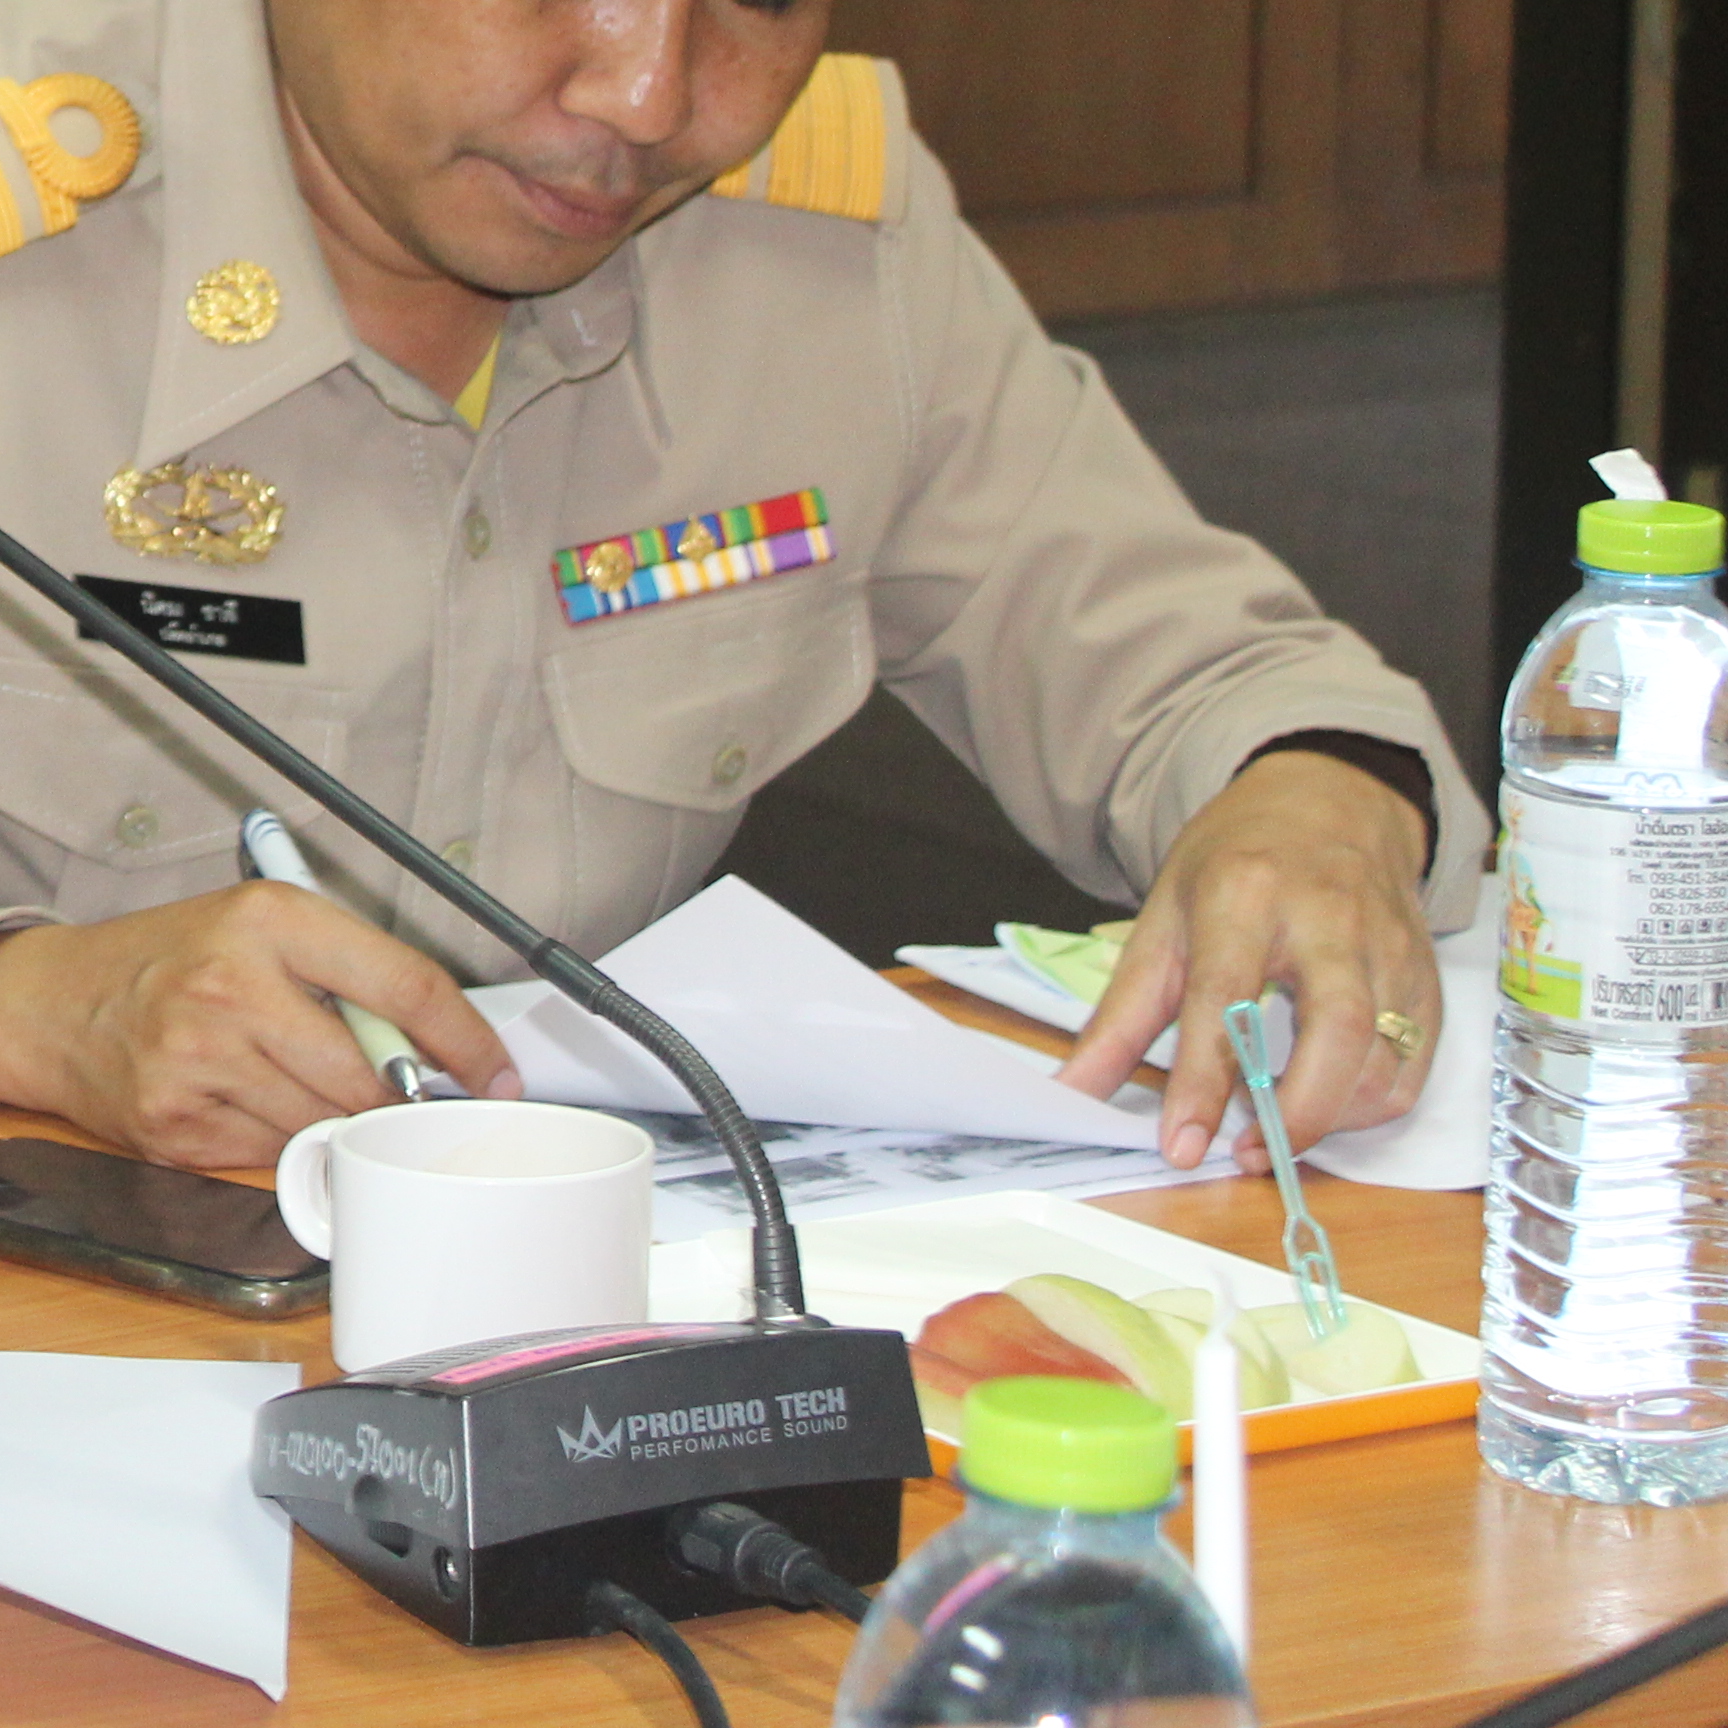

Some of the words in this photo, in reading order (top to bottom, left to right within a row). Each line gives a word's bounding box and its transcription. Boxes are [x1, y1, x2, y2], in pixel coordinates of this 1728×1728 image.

[1657, 982, 1683, 1021] 600
[627, 1398, 766, 1442] PROEURO
[775, 1386, 847, 1420] TECH
[630, 1426, 774, 1461] PERFOMANCE
[783, 1415, 848, 1438] SOUND
